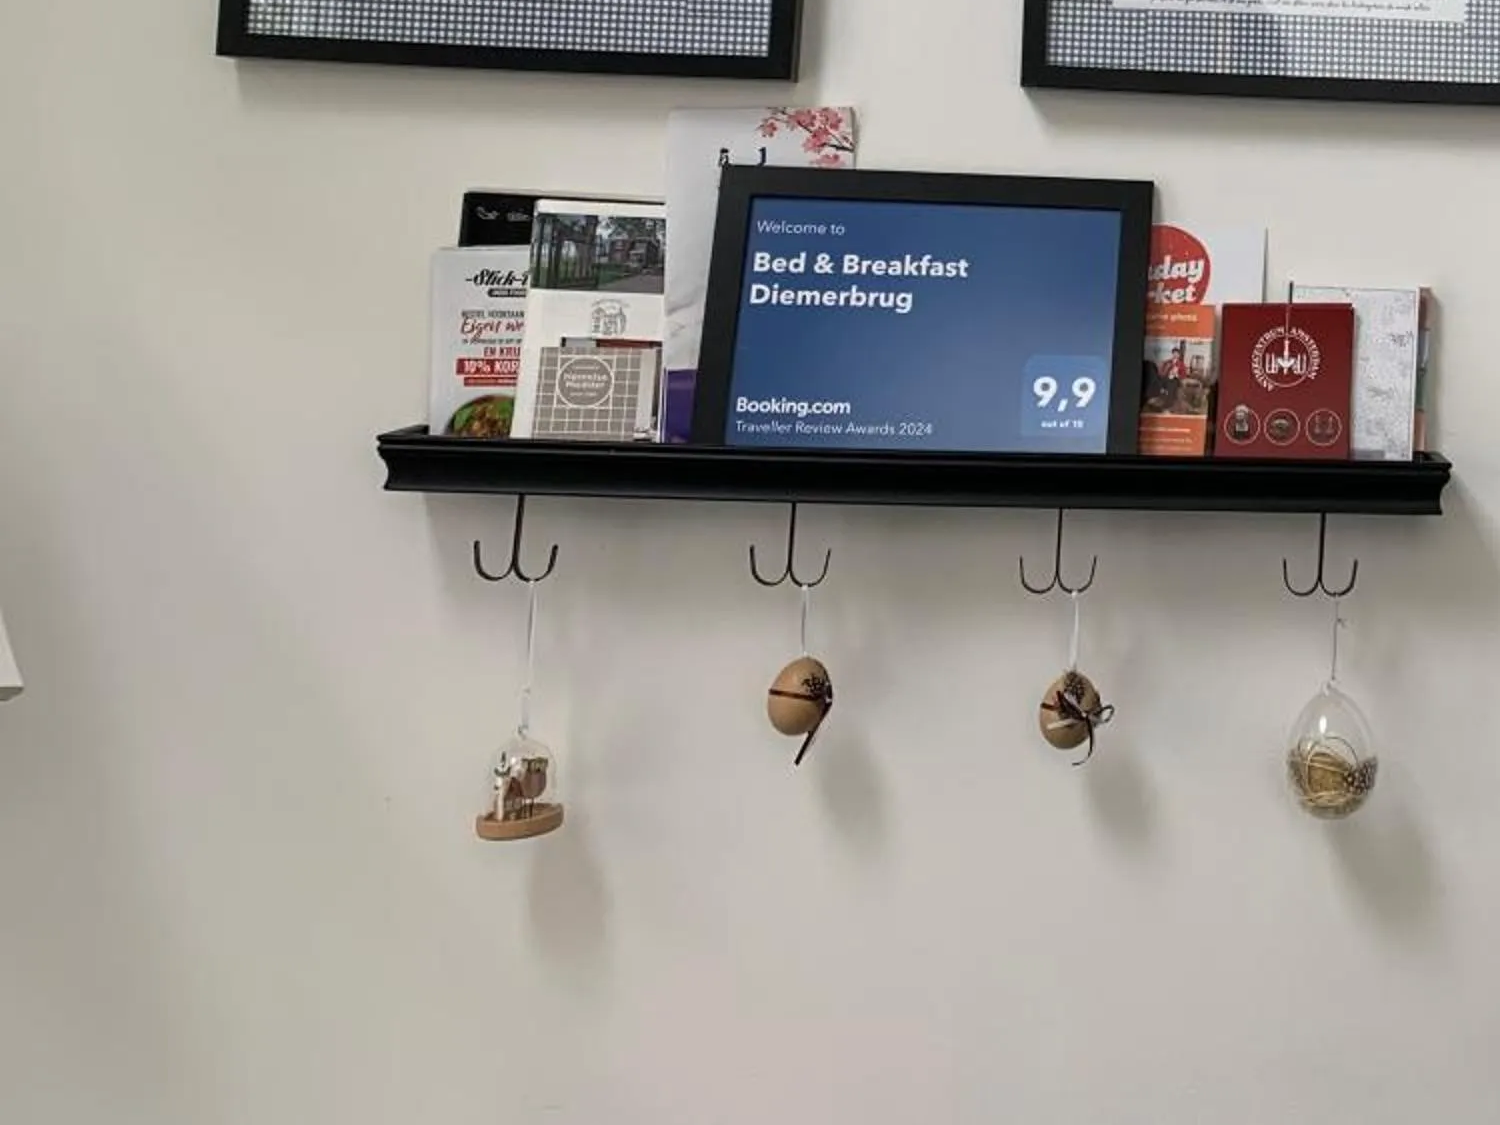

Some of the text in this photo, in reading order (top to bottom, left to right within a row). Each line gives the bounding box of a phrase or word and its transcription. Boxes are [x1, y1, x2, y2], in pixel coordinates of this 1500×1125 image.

[757, 220, 846, 236] Welcome to
[753, 252, 969, 278] Bed & Breakfast
[750, 283, 913, 314] Diemerbrug
[1033, 376, 1097, 412] 9,9
[736, 396, 851, 417] Booking.com
[736, 420, 933, 436] Traveller Review Awards 2024
